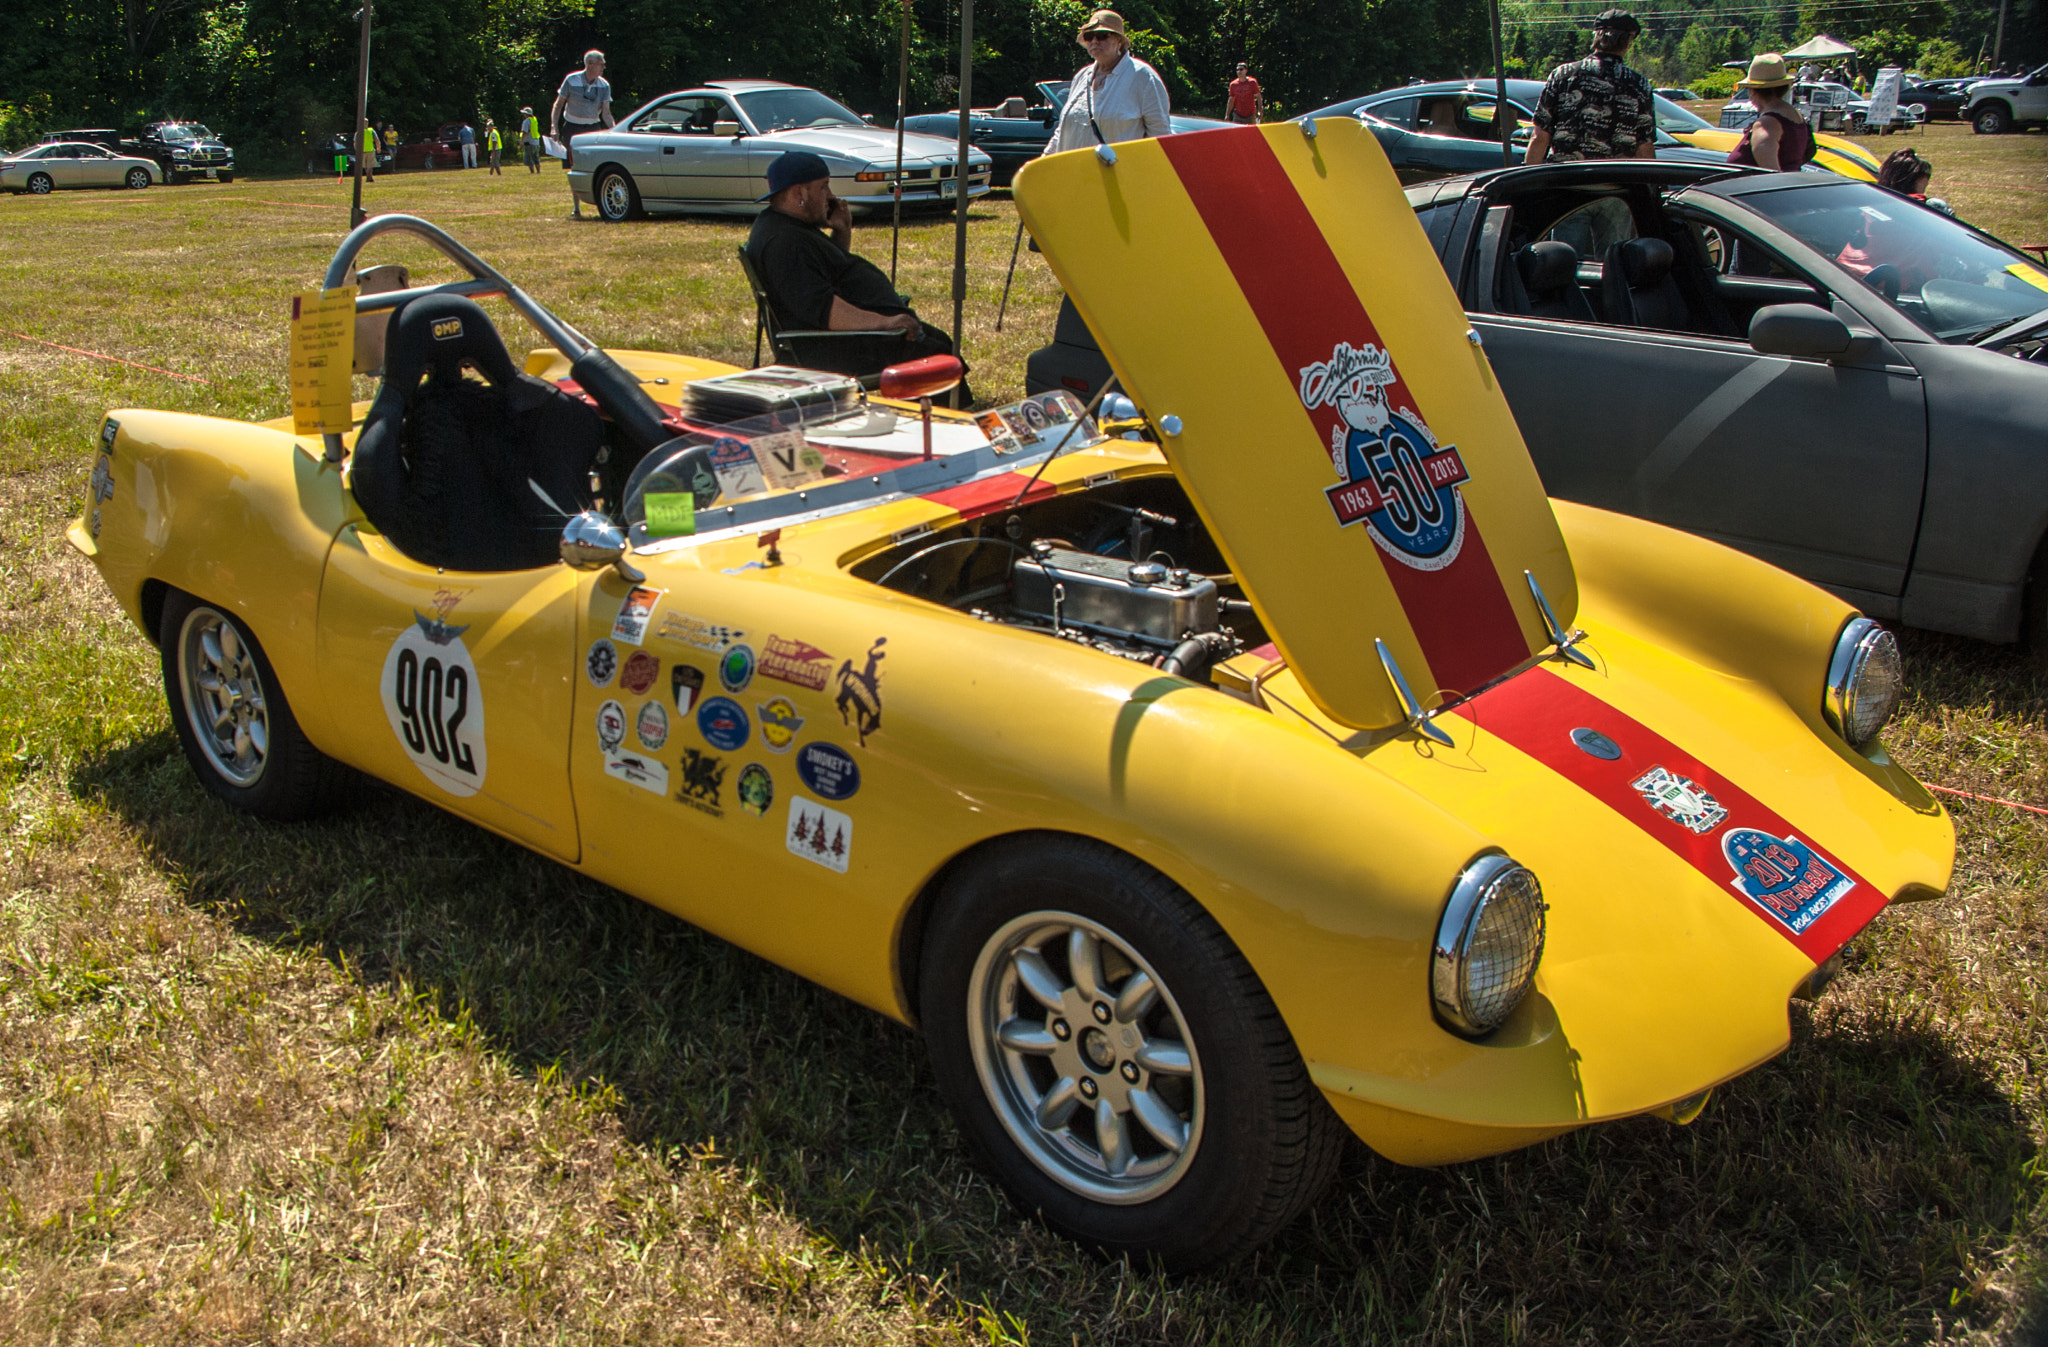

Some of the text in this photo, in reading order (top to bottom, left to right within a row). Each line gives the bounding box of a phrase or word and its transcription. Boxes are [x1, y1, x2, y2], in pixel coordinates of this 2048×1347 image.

[434, 320, 461, 337] OMP
[1303, 345, 1388, 406] California
[1371, 369, 1394, 384] BUST!
[1366, 415, 1378, 425] to
[1400, 407, 1437, 444] COAST
[772, 447, 796, 472] V
[1332, 425, 1345, 477] COAST
[1430, 457, 1459, 482] 2013
[1358, 433, 1443, 536] 50
[1339, 487, 1373, 514] 1963
[1408, 526, 1449, 548] YEARS
[395, 647, 478, 776] 902
[806, 748, 853, 776] SMOKEY'S
[1756, 853, 1836, 919] PUT-IN-BAY
[1792, 911, 1812, 931] ROAD
[1808, 897, 1829, 917] RACES
